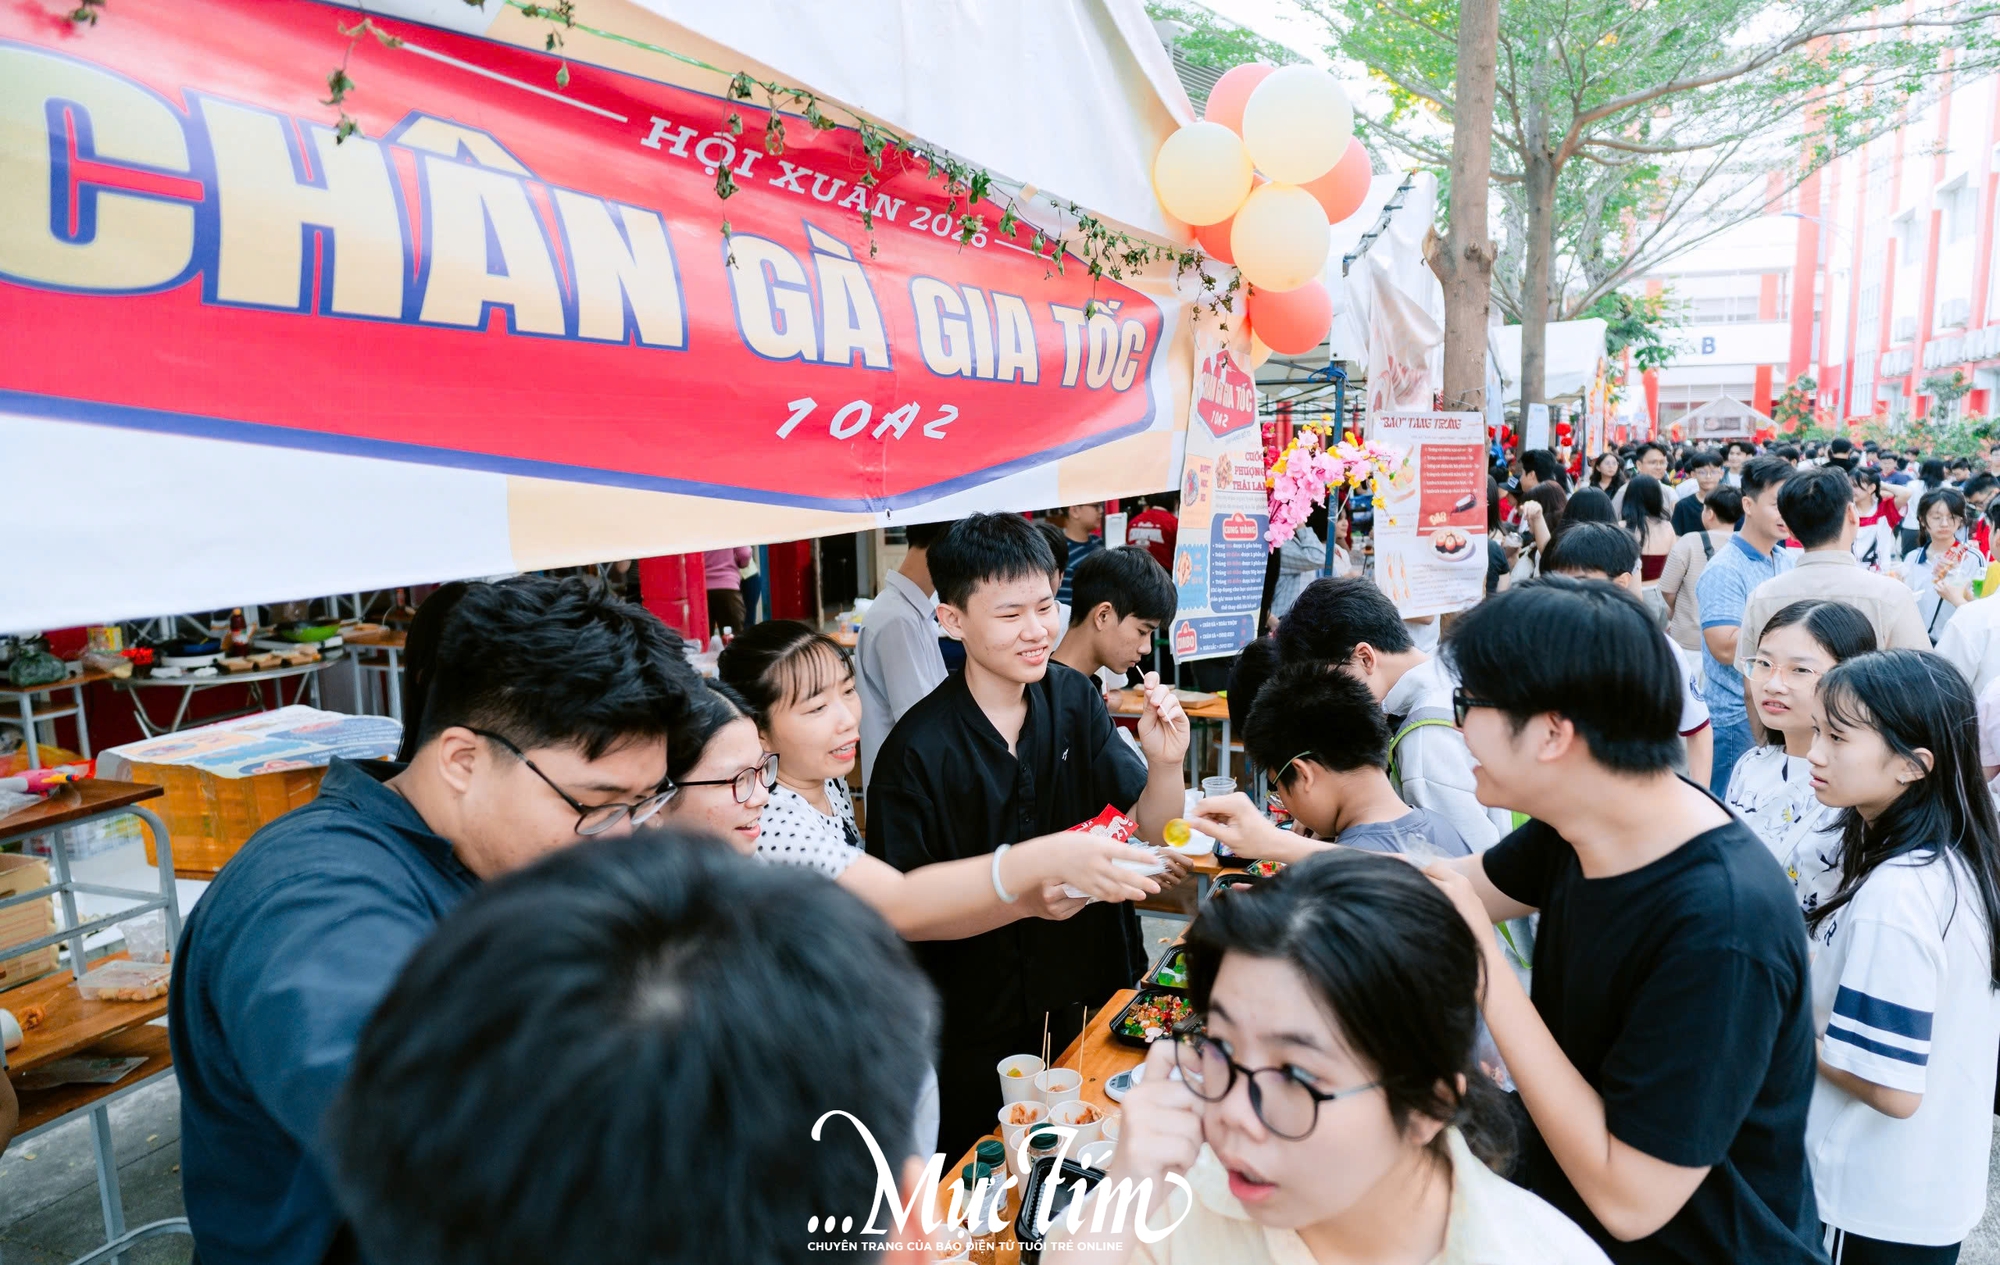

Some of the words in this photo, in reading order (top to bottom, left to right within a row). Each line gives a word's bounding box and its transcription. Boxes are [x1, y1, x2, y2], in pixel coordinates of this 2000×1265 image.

[0, 40, 687, 351] CHÂN
[723, 219, 893, 371] GÀ
[909, 276, 1039, 385] GIA
[1050, 300, 1147, 392] TỐC
[641, 116, 766, 178] HỘI
[769, 164, 905, 221] XUÂN
[1702, 336, 1716, 354] B
